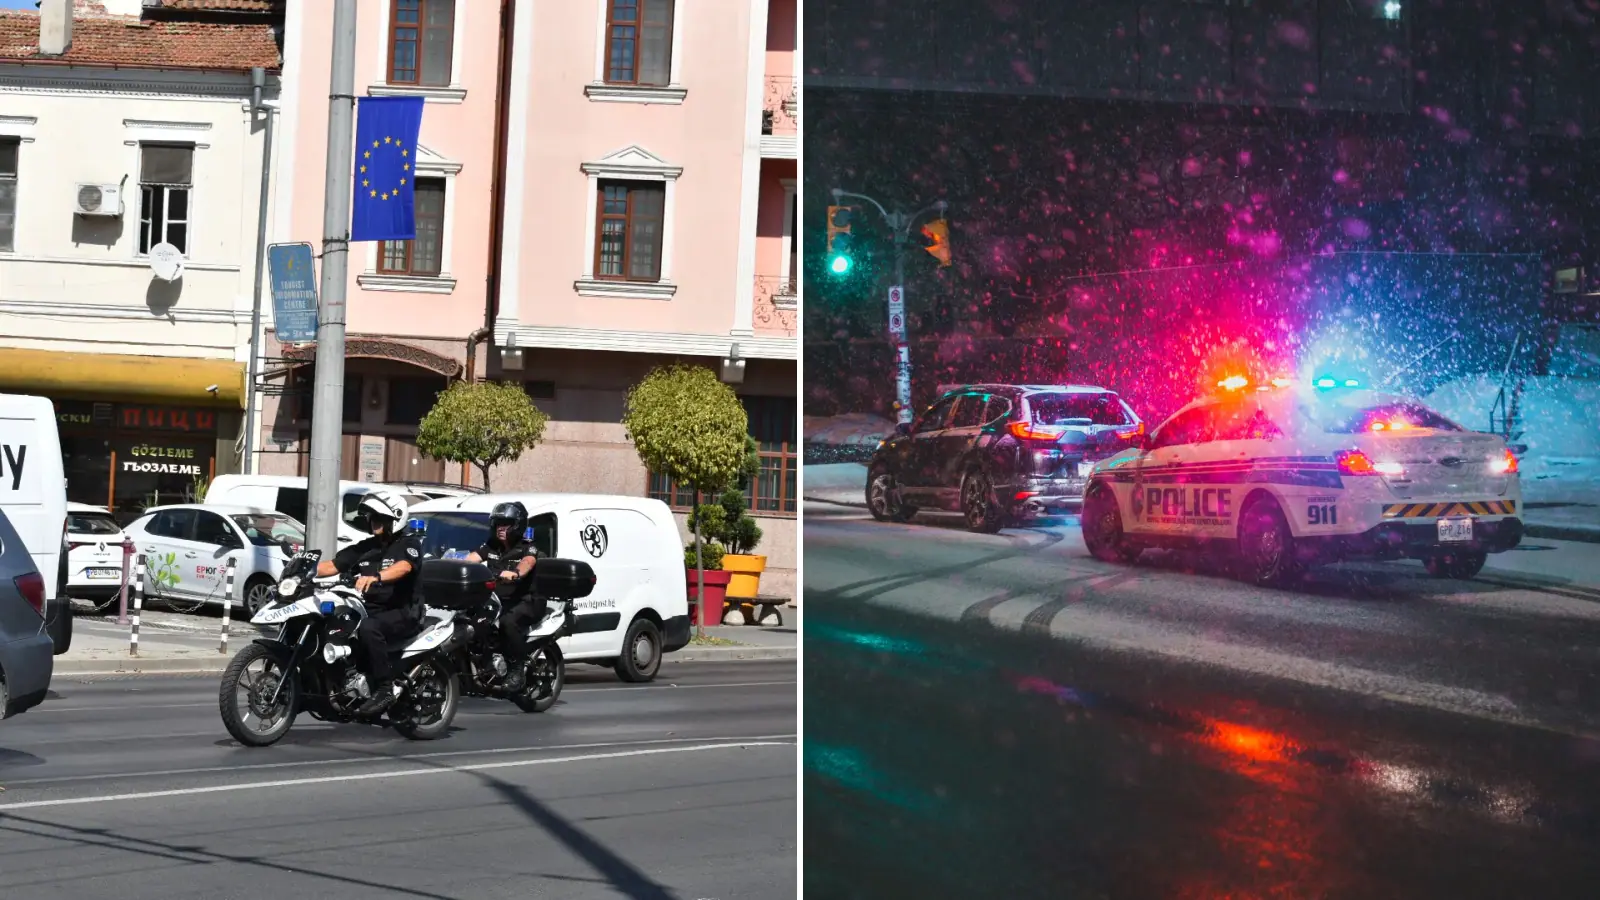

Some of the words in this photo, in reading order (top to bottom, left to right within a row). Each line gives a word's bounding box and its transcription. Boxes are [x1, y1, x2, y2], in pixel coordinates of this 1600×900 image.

[281, 280, 305, 290] TOURIST
[283, 300, 306, 310] CENTRE
[131, 443, 195, 459] GÖZLEME
[0, 443, 27, 491] y
[1147, 487, 1232, 517] POLICE
[1307, 504, 1337, 525] 911
[574, 598, 616, 610] ww.bgpost.bg
[264, 604, 300, 622] СИГМА
